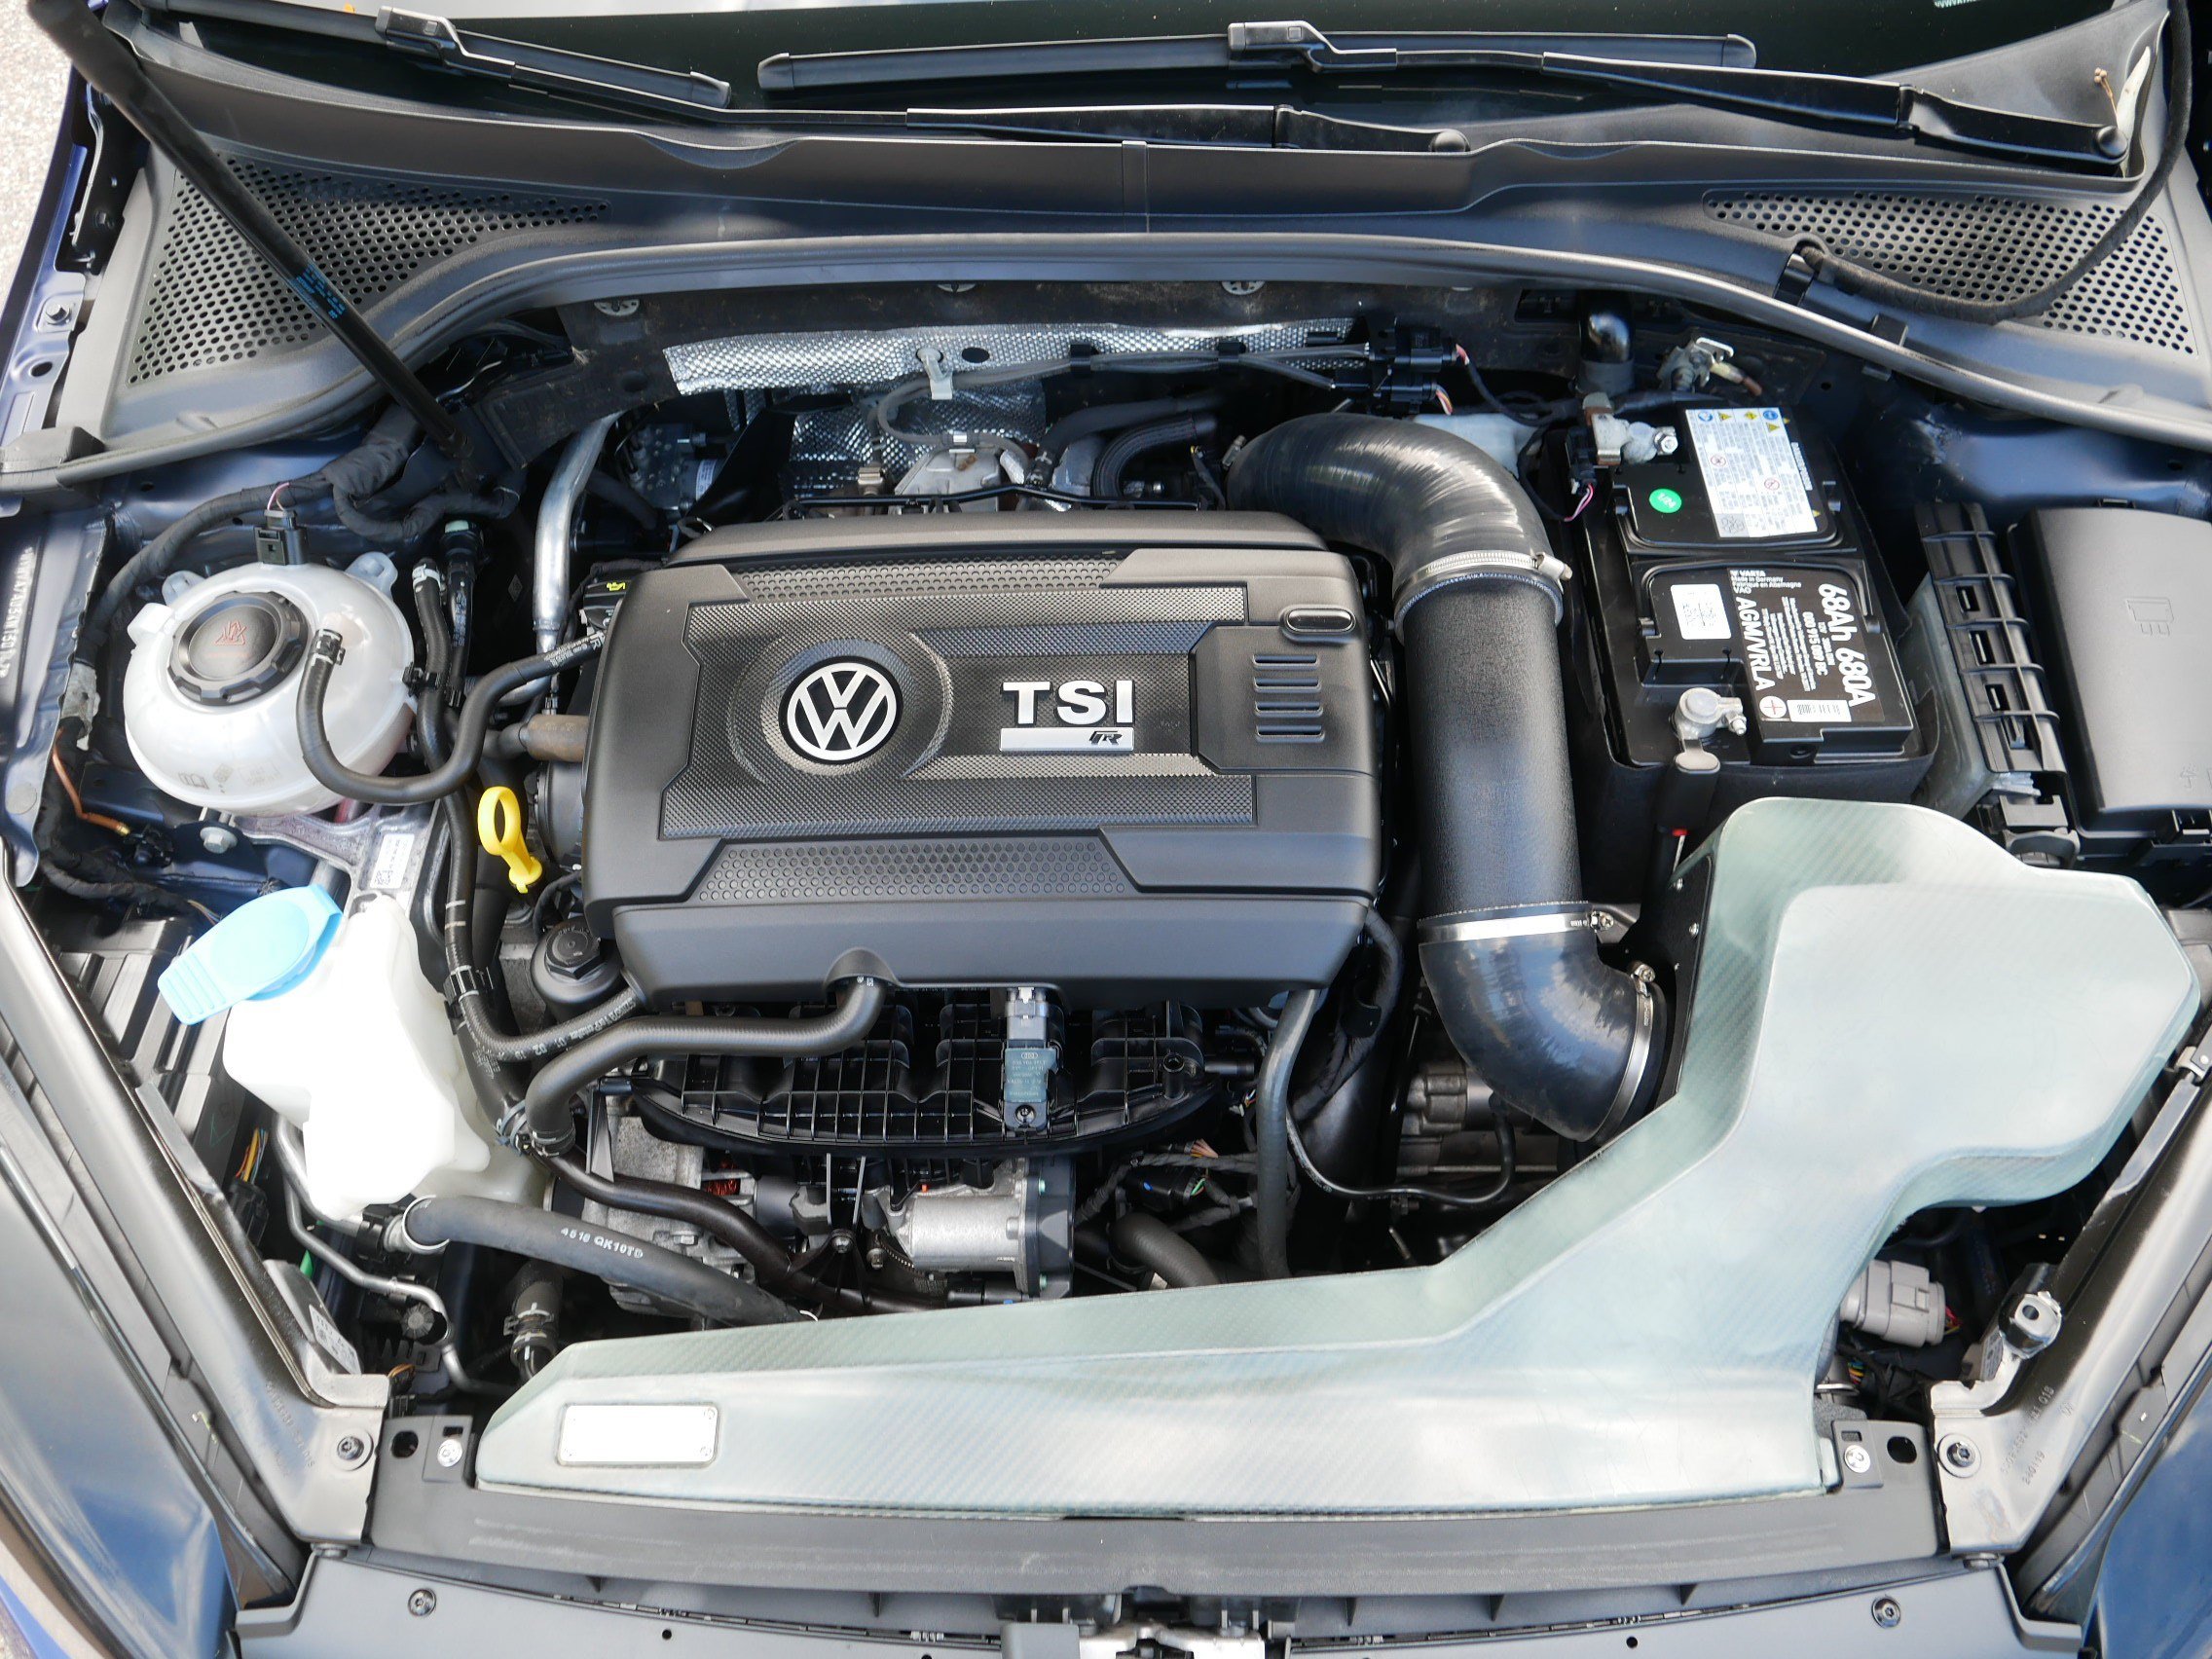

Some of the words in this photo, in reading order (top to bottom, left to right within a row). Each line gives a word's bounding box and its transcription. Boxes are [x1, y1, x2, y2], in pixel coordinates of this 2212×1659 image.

[1818, 583, 1858, 642] 68Ah
[1736, 597, 1776, 691] AGM/VRLA
[1003, 681, 1133, 724] TSI
[1835, 647, 1875, 707] 680A
